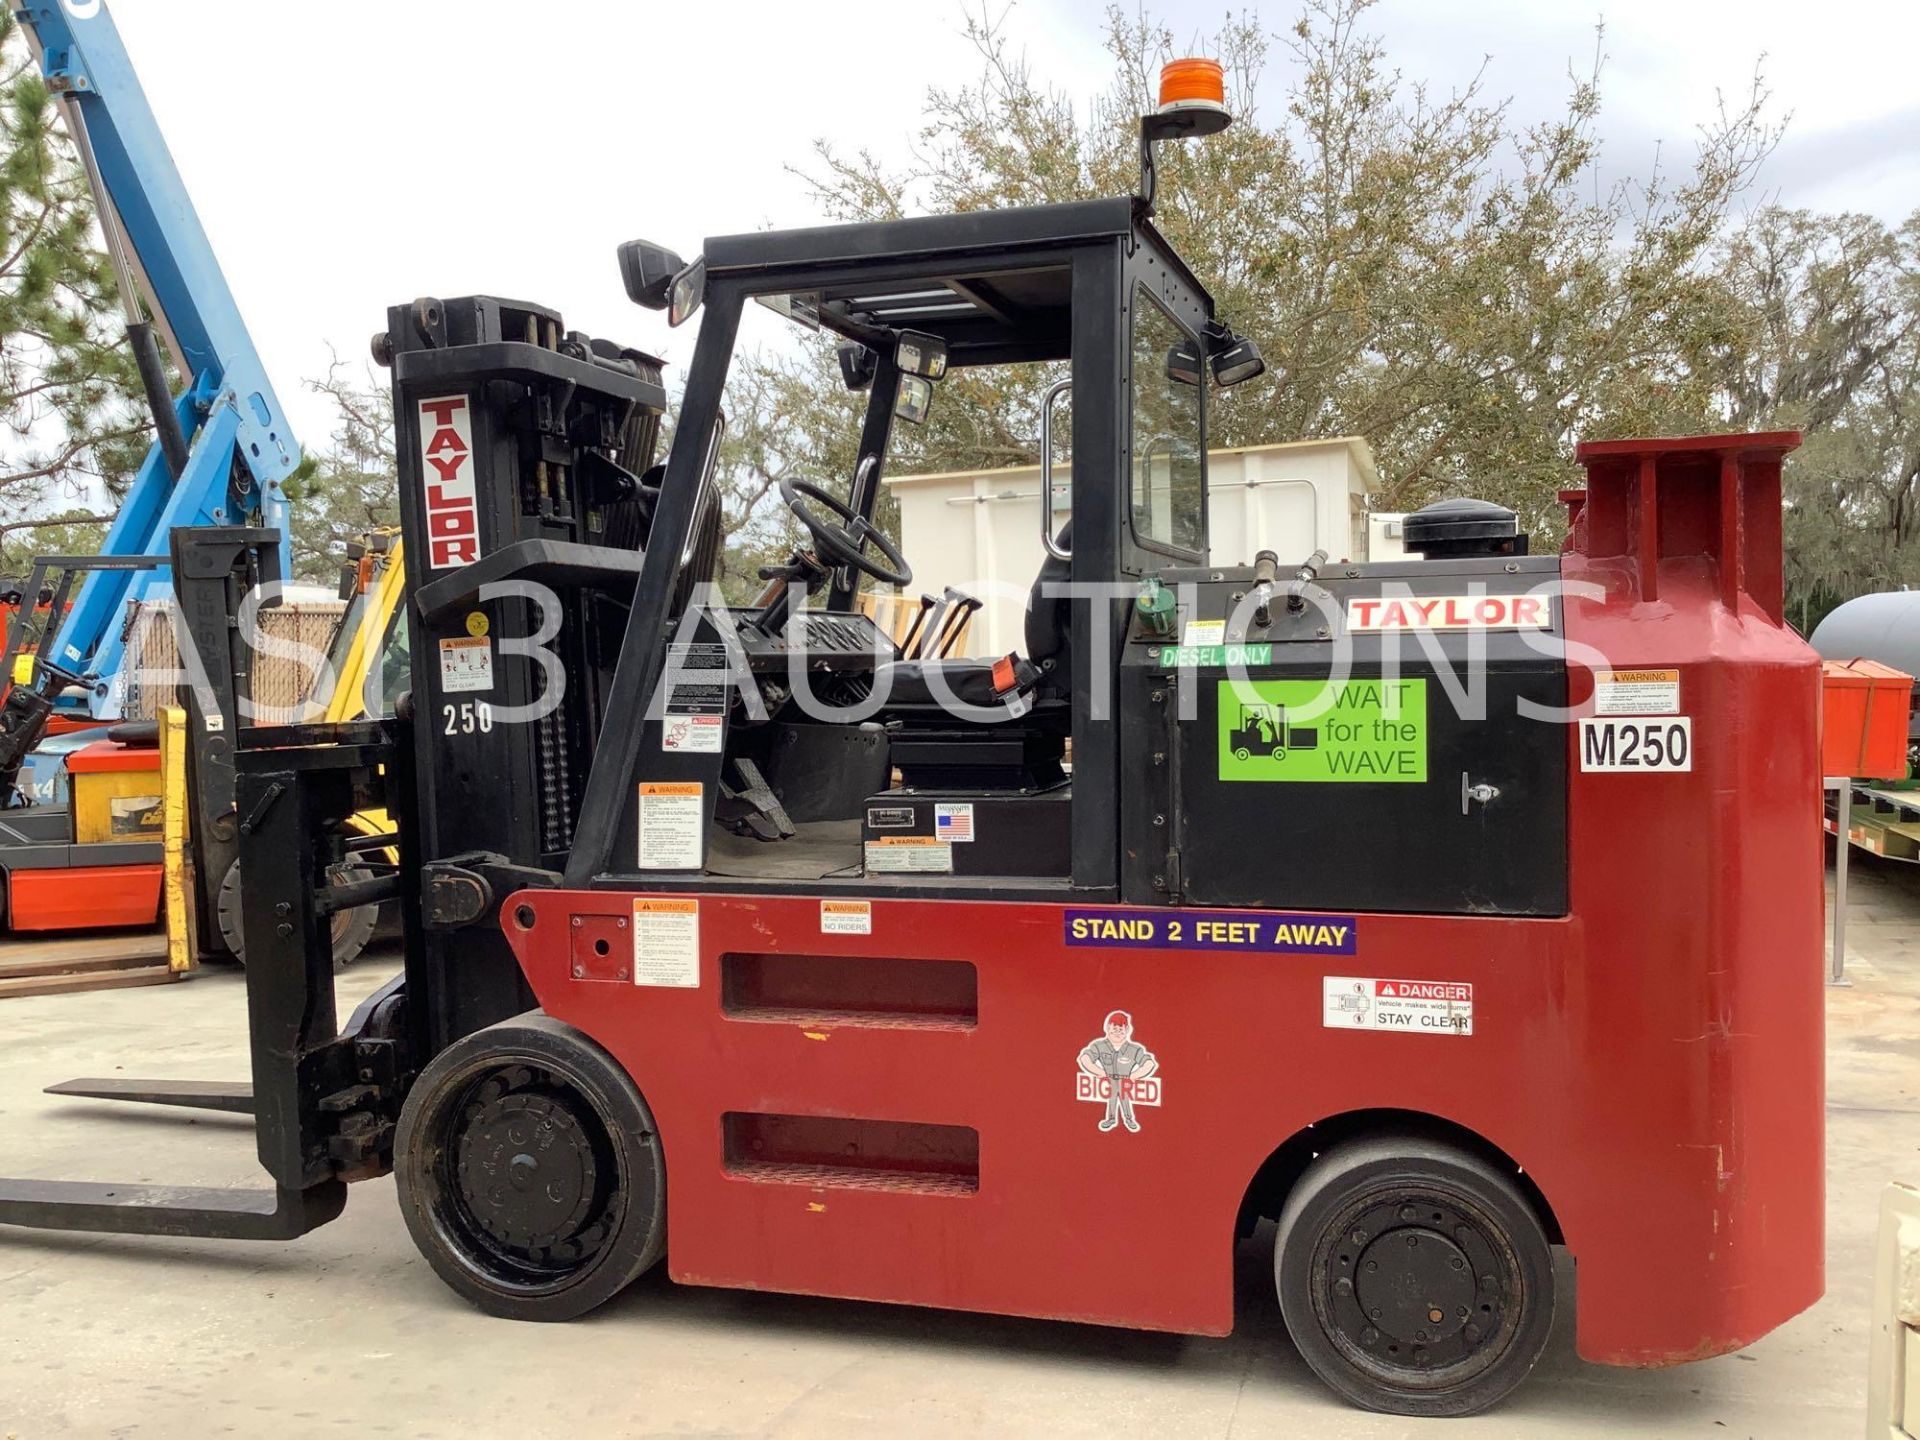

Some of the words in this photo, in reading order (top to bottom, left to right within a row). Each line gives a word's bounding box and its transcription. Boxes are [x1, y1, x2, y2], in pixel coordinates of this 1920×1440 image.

[421, 398, 477, 565] TAYLOR
[1352, 599, 1541, 627] TAYLOR
[1163, 645, 1221, 668] DIESEL
[1226, 644, 1270, 666] ONLY
[1621, 672, 1667, 682] WARNING
[1332, 685, 1411, 709] WAIT
[443, 703, 492, 735] 250
[1325, 719, 1363, 742] for
[1373, 718, 1417, 742] the
[1585, 724, 1688, 767] M250
[1325, 750, 1417, 774] WAVE
[1072, 918, 1154, 941] STAND
[1167, 921, 1182, 941] 2
[1196, 922, 1260, 944] FEET
[1274, 924, 1348, 947] AWAY
[1378, 1000, 1402, 1008] Vehicle
[1400, 984, 1467, 1000] DANGER
[1378, 1012, 1413, 1025] STAY
[1420, 1015, 1468, 1029] CLEAR
[1080, 1075, 1112, 1099] BIG
[1120, 1078, 1159, 1103] RED
